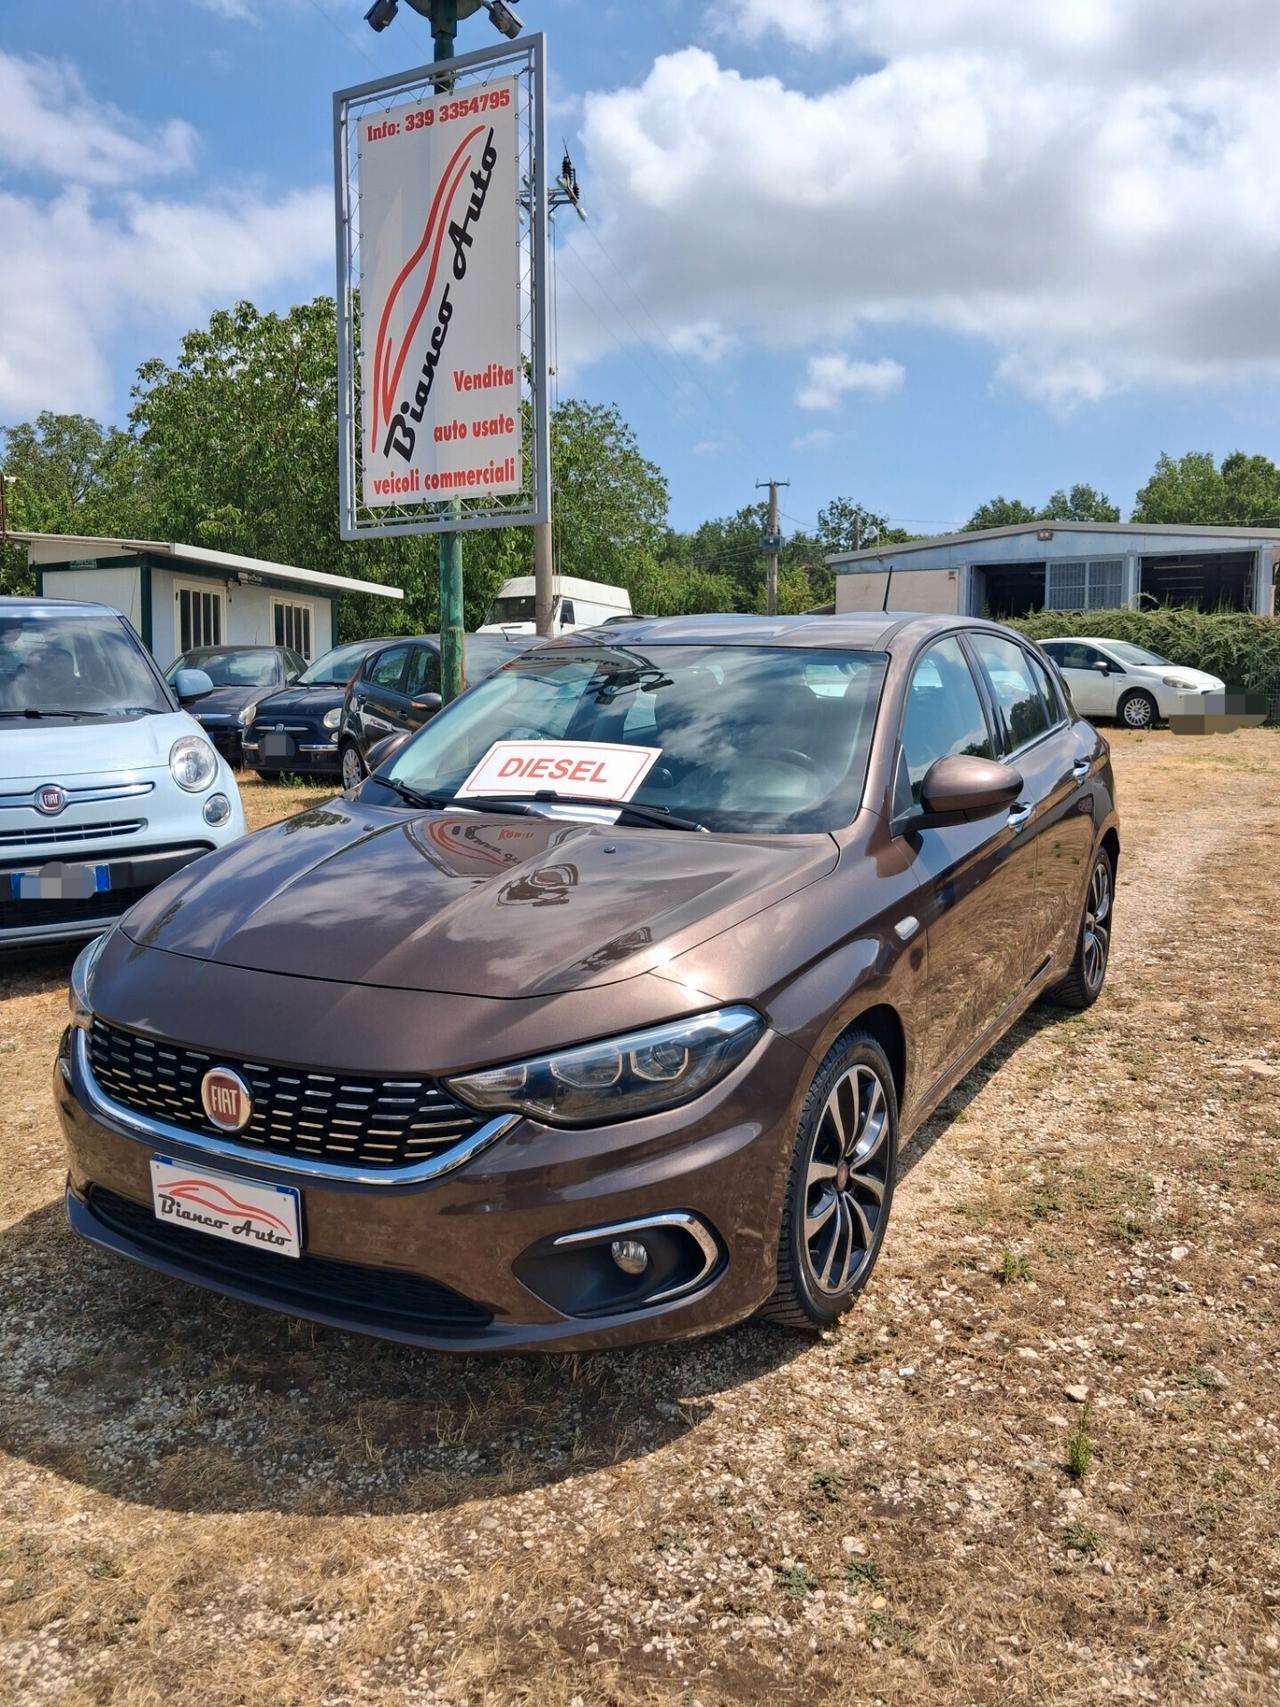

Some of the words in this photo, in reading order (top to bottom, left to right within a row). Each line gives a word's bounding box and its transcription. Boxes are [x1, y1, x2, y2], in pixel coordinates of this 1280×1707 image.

[367, 122, 400, 142] Info:
[405, 109, 435, 132] 339
[439, 89, 510, 123] 3354795
[383, 282, 453, 463] Bianco
[448, 127, 498, 281] Auto
[453, 363, 514, 392] Vendita
[433, 419, 468, 443] auto
[472, 413, 515, 437] usate
[373, 468, 420, 495] veicoli
[424, 457, 515, 490] commerciali
[498, 757, 608, 783] DIESEL
[43, 794, 58, 804] FIAT
[210, 1085, 238, 1116] FIAT
[157, 1193, 229, 1230] Bianco
[231, 1220, 292, 1247] Auto
